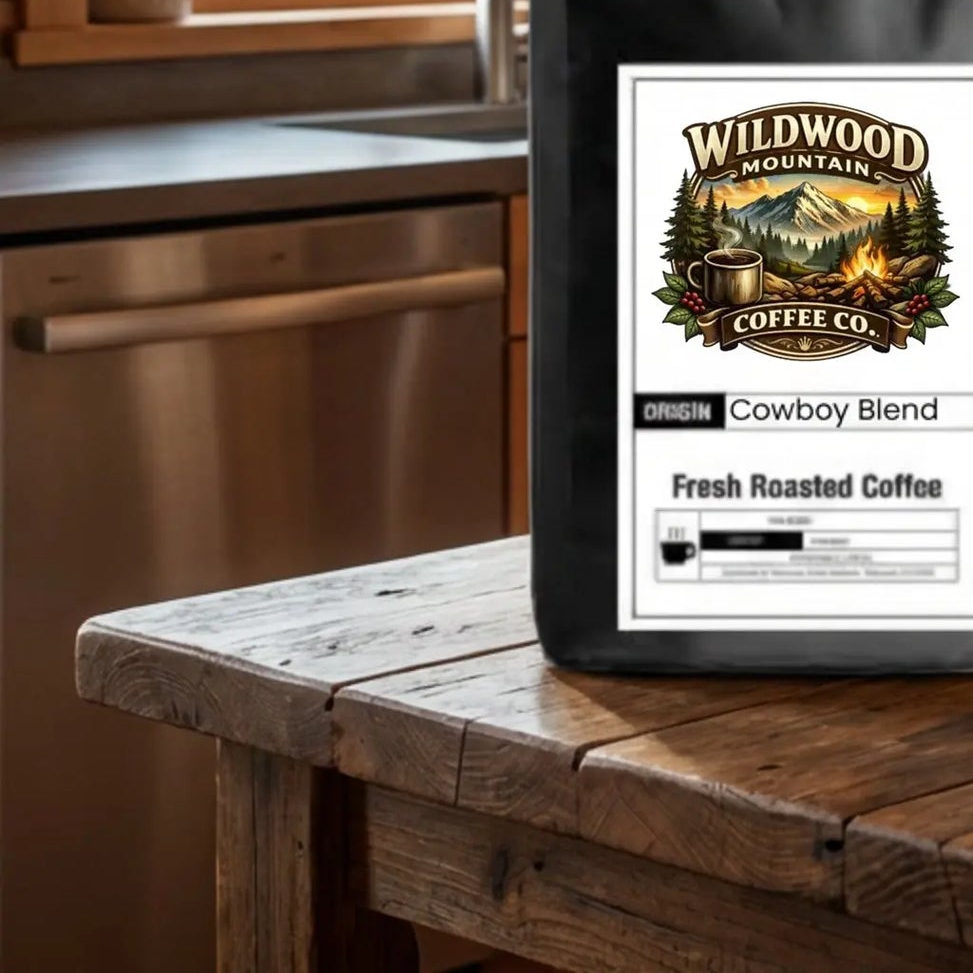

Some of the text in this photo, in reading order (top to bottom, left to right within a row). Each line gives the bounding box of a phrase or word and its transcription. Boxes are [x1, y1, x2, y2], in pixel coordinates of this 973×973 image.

[687, 113, 926, 172] WILDWOOD
[742, 154, 870, 177] MOUNTAIN
[733, 308, 827, 333] COFFEE
[729, 397, 938, 428] Cowboy Blend
[672, 473, 942, 499] Fresh Roasted Coffee
